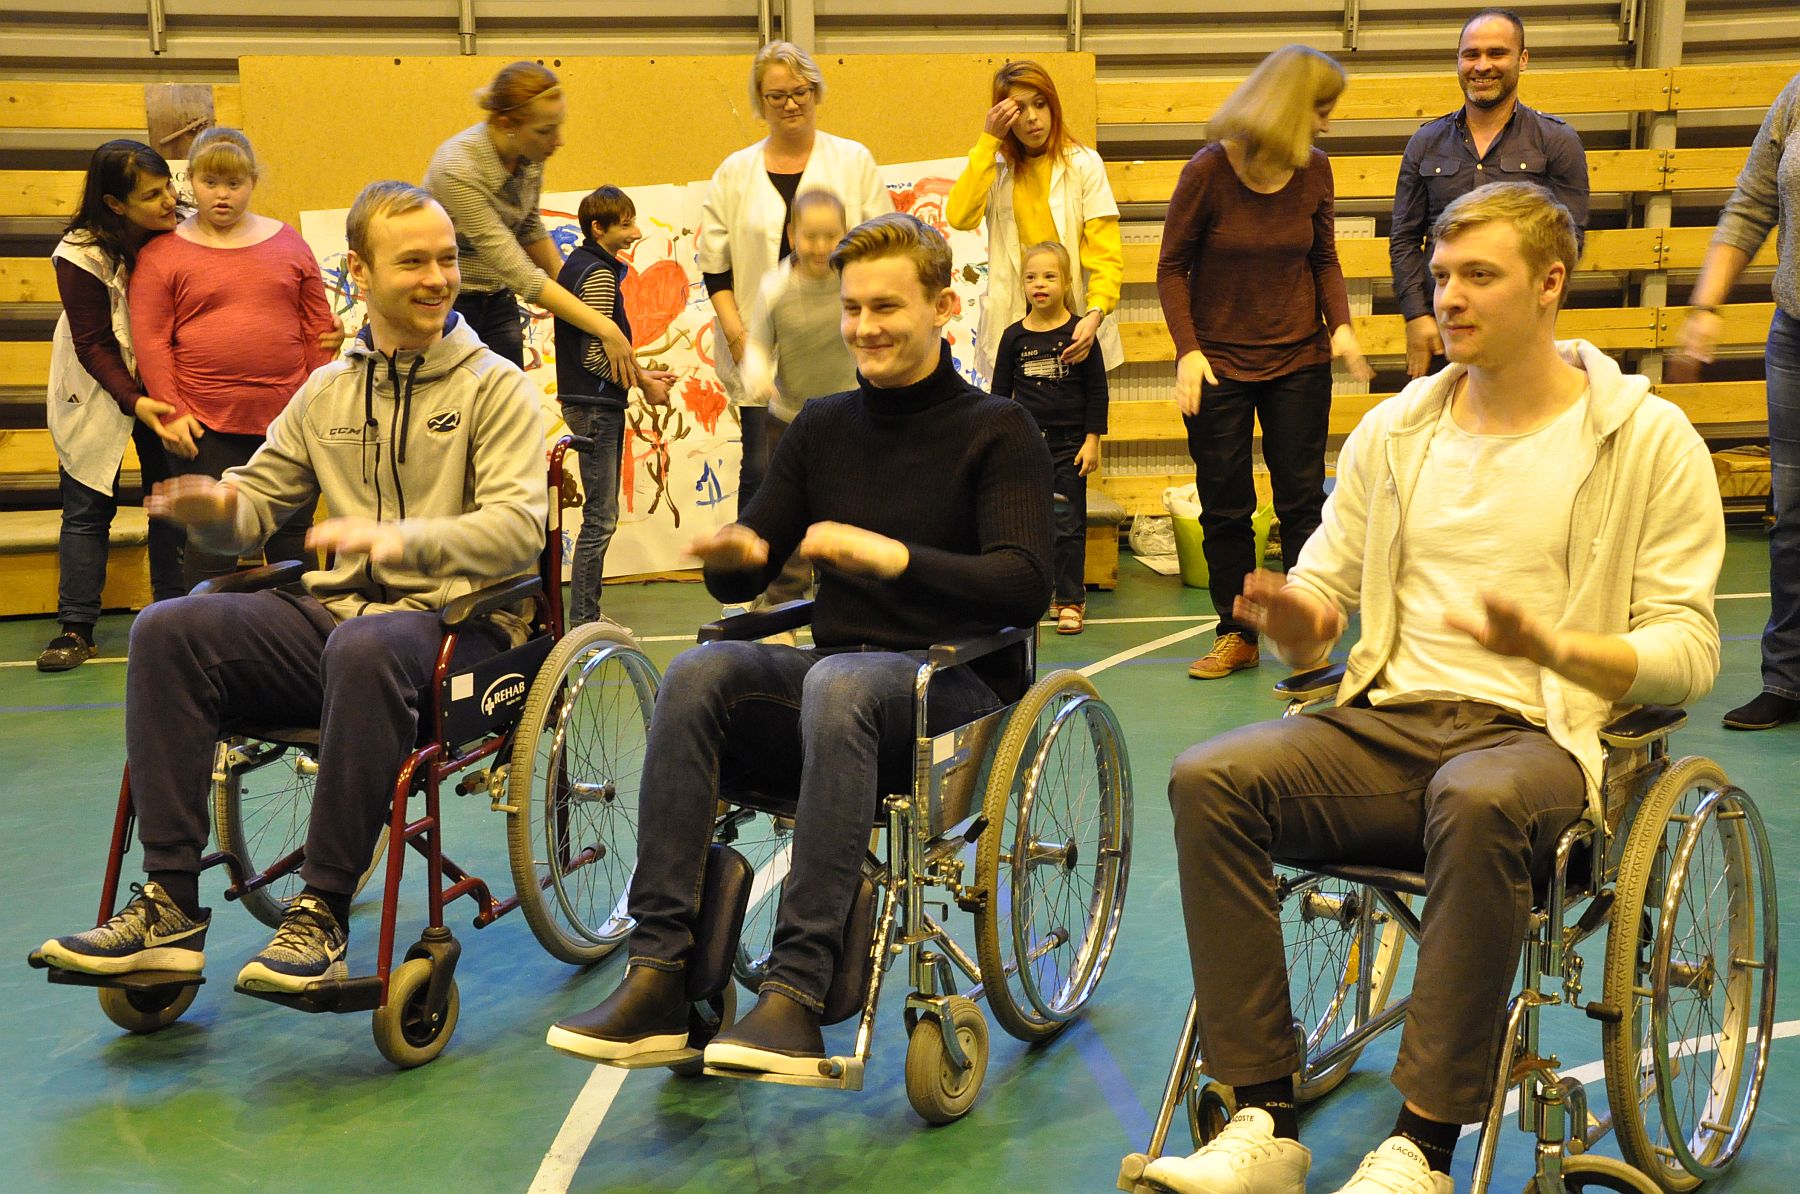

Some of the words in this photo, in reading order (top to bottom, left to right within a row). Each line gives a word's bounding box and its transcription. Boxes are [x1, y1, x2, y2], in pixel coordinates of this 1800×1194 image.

[329, 427, 362, 436] CCM
[494, 681, 525, 704] REHAB
[1231, 1114, 1255, 1122] ACOSTE
